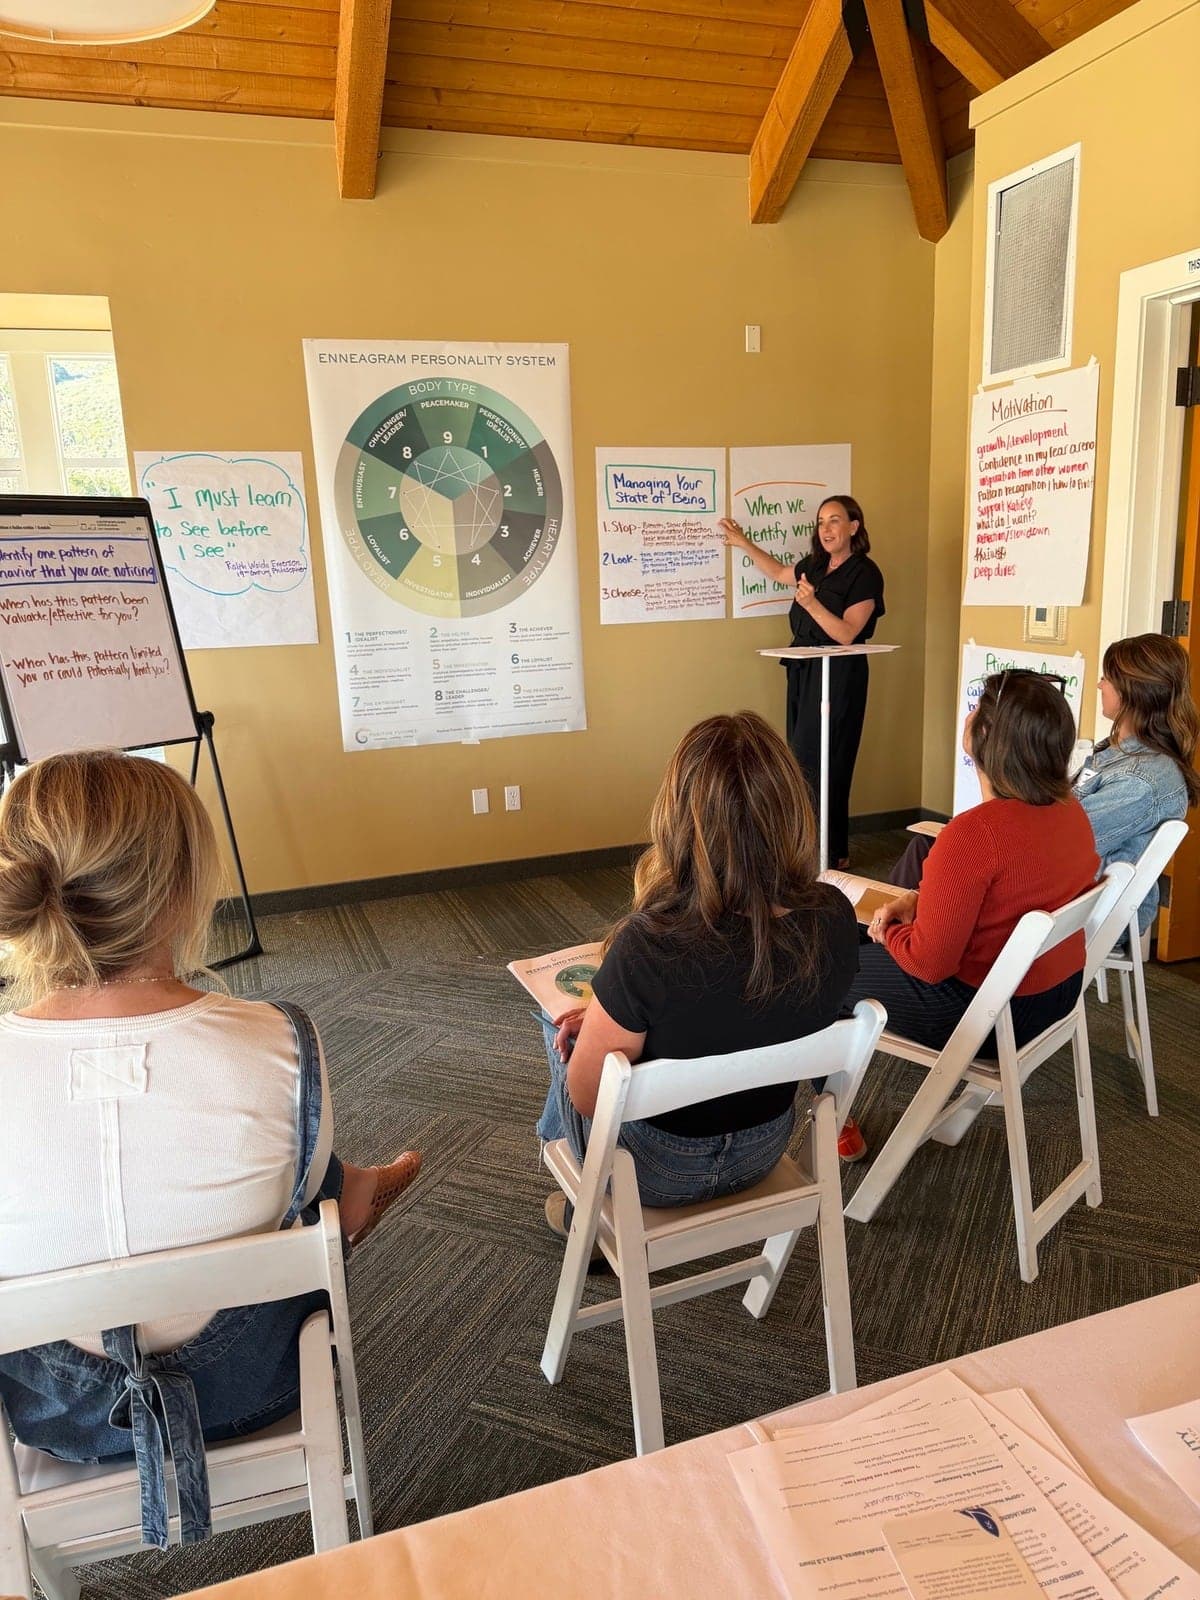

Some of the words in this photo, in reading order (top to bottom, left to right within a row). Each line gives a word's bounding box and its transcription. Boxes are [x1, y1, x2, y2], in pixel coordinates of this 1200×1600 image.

[318, 353, 407, 364] ENNEAGRAM
[411, 354, 503, 366] PERSONALITY
[506, 355, 556, 366] SYSTEM
[408, 380, 442, 396] BODY
[446, 380, 479, 396] TYPE
[420, 399, 470, 409] PEACEMAKER
[368, 408, 407, 448] CHALLENGER/
[380, 421, 404, 445] LEADER
[443, 431, 453, 444] 9
[479, 407, 527, 449] PERFECTIONIST/
[485, 419, 514, 445] IDEALIST
[402, 446, 413, 459] 8
[481, 446, 489, 459] 1
[1025, 453, 1034, 463] in
[1035, 450, 1048, 466] my
[1059, 462, 1089, 474] women
[356, 461, 367, 509] ENTHUSIAST
[503, 485, 512, 497] 2
[532, 467, 544, 497] HELPER
[613, 472, 671, 495] Managing
[676, 473, 703, 491] Your
[248, 484, 292, 508] learn
[388, 486, 397, 499] 7
[616, 491, 648, 504] State
[652, 490, 665, 504] of
[672, 492, 707, 509] Being
[744, 494, 782, 517] When
[156, 519, 172, 539] to
[217, 517, 272, 537] before
[399, 528, 409, 541] 6
[500, 525, 510, 538] 3
[741, 521, 787, 546] dentify
[345, 527, 366, 559] TYPE
[522, 528, 542, 563] ACHIEVER
[541, 518, 559, 559] HEART
[0, 546, 33, 567] entify
[37, 550, 57, 560] one
[59, 545, 98, 562] pattern
[102, 544, 115, 559] of
[178, 545, 187, 561] I
[367, 534, 392, 566] LOYALIST
[471, 553, 481, 566] 4
[432, 555, 442, 567] 5
[0, 564, 37, 579] havior
[40, 564, 66, 579] that
[70, 566, 89, 582] you
[91, 568, 108, 578] are
[113, 562, 158, 584] noticing
[522, 560, 545, 586] TYPE
[465, 574, 512, 598] INDIVIDUALIST
[741, 575, 767, 596] limit
[0, 598, 30, 611] When
[31, 595, 53, 608] has
[54, 595, 78, 608] this
[81, 593, 121, 609] pattern
[120, 591, 149, 605] been
[98, 603, 113, 619] for
[113, 606, 139, 626] you?
[345, 632, 352, 643] 1
[430, 627, 438, 639] 2
[509, 622, 517, 634] 3
[48, 651, 71, 665] has
[70, 650, 91, 663] this
[94, 648, 129, 663] pattern
[130, 645, 163, 660] limited
[432, 658, 441, 670] 5
[511, 653, 520, 665] 6
[17, 673, 38, 688] you
[43, 670, 54, 681] or
[57, 667, 83, 680] could
[133, 662, 151, 677] limit
[349, 664, 359, 675] 4
[434, 690, 443, 701] 8
[513, 684, 522, 695] 9
[352, 696, 360, 708] 7
